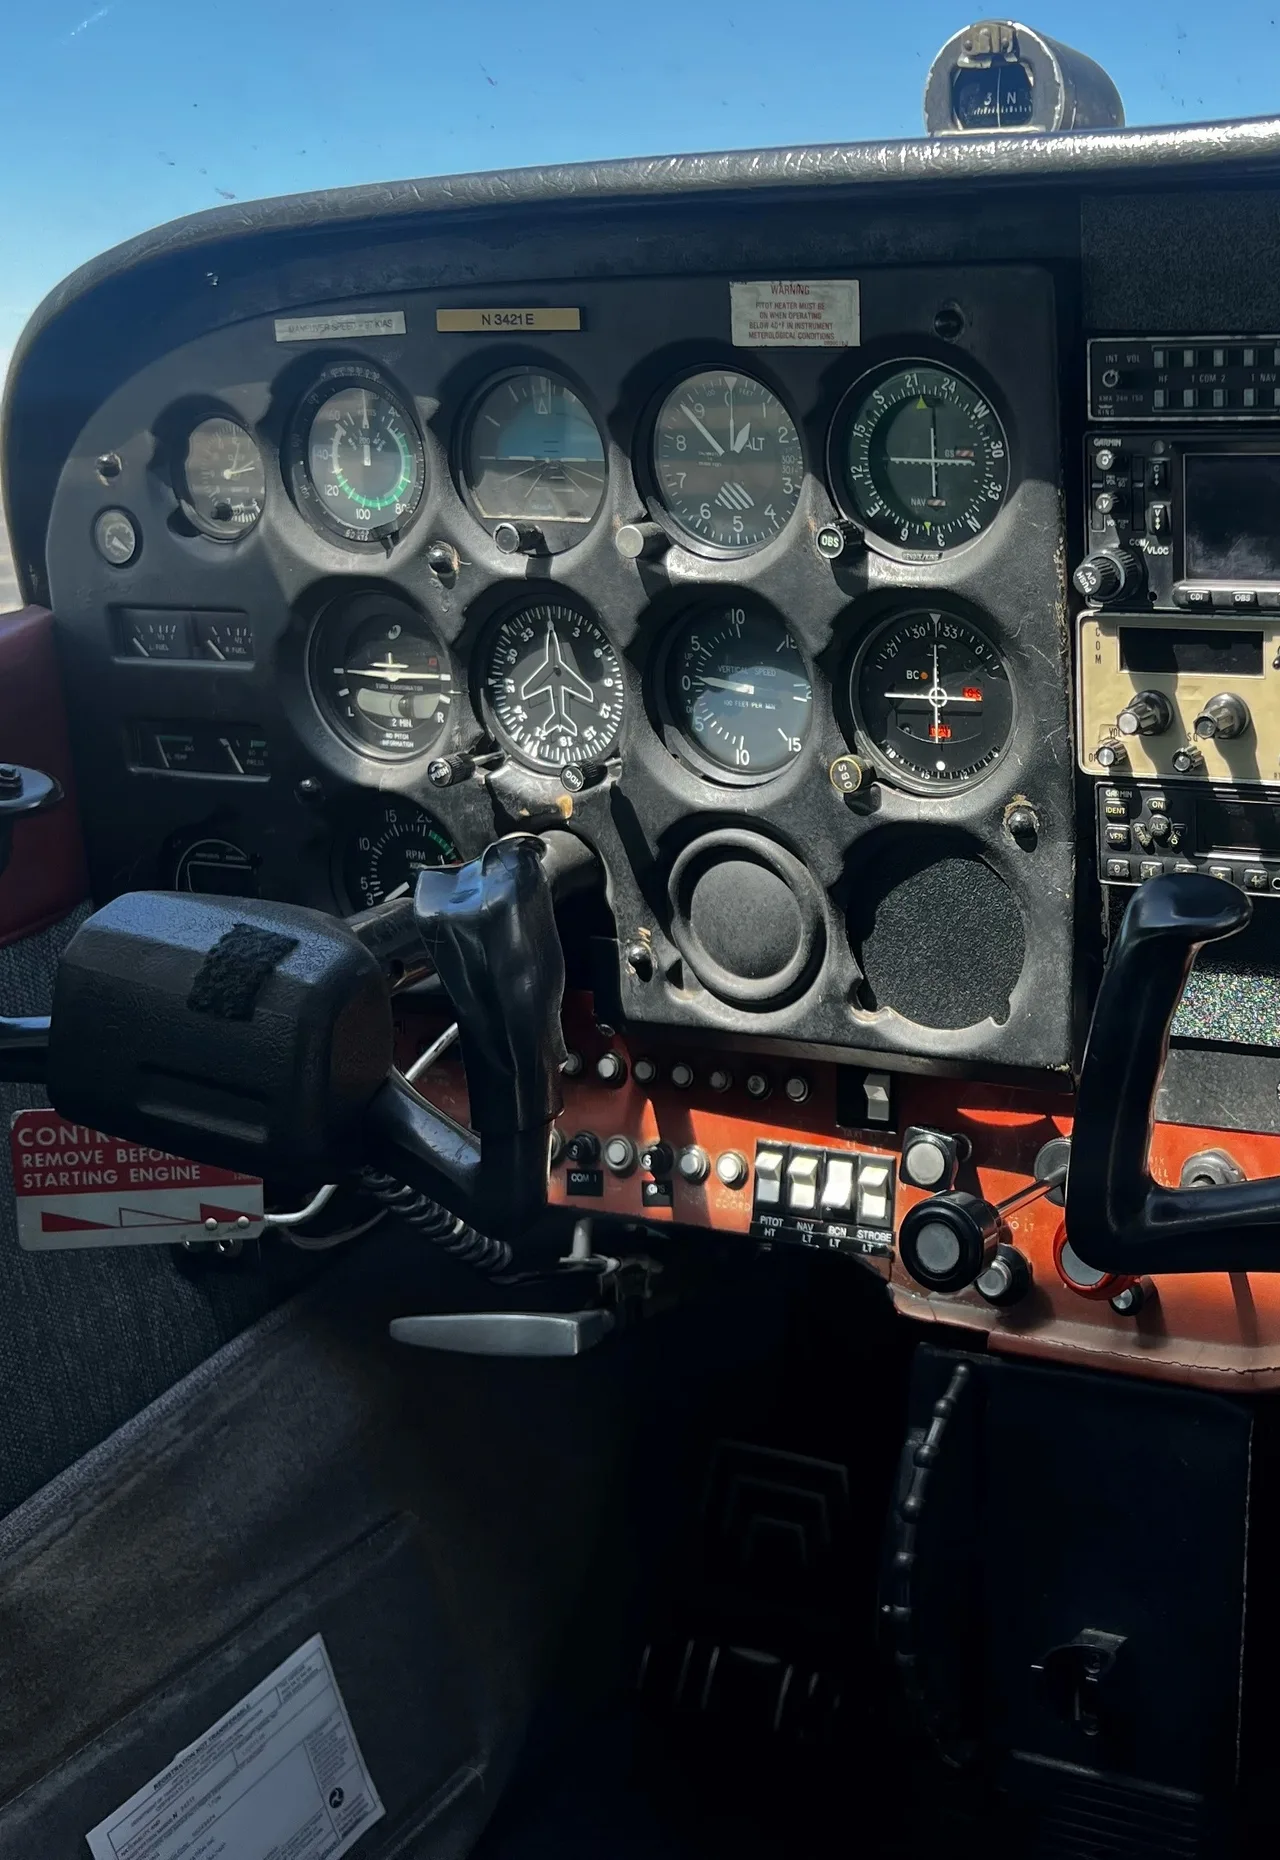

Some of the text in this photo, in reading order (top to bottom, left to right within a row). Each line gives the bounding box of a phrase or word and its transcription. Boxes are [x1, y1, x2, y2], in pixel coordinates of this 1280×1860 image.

[984, 92, 1016, 105] 3 N
[771, 285, 810, 295] WARNING
[374, 319, 392, 328] KIAS
[1106, 355, 1118, 363] INT
[1199, 375, 1216, 383] COM
[1221, 374, 1226, 382] 2
[325, 486, 339, 496] 120
[911, 498, 926, 506] NAV
[356, 509, 371, 520] 100
[821, 535, 839, 548] OBS
[1077, 572, 1091, 593] PUSH
[718, 665, 776, 676] VERTICAL SPEED
[907, 670, 919, 679] BC
[392, 718, 396, 726] 2
[1109, 728, 1122, 737] VOL
[788, 737, 801, 751] 15
[736, 749, 750, 765] 10
[837, 764, 853, 789] OBS
[1106, 790, 1132, 798] GARMIN
[1106, 806, 1125, 814] IDENT
[1152, 801, 1163, 809] ON
[385, 810, 397, 823] 15
[1171, 832, 1181, 845] OFF
[359, 837, 369, 851] 10
[406, 850, 425, 860] RPM
[23, 1150, 104, 1168] REMOVE
[24, 1165, 200, 1188] STARTING ENGINE
[571, 1173, 589, 1182] COM
[760, 1216, 783, 1226] PITOT
[797, 1222, 814, 1231] NAV
[828, 1226, 846, 1237] BCN
[764, 1228, 776, 1237] HT
[856, 1230, 892, 1242] STROBE
[802, 1234, 812, 1243] LT
[830, 1239, 840, 1248] LT
[863, 1244, 873, 1253] LT
